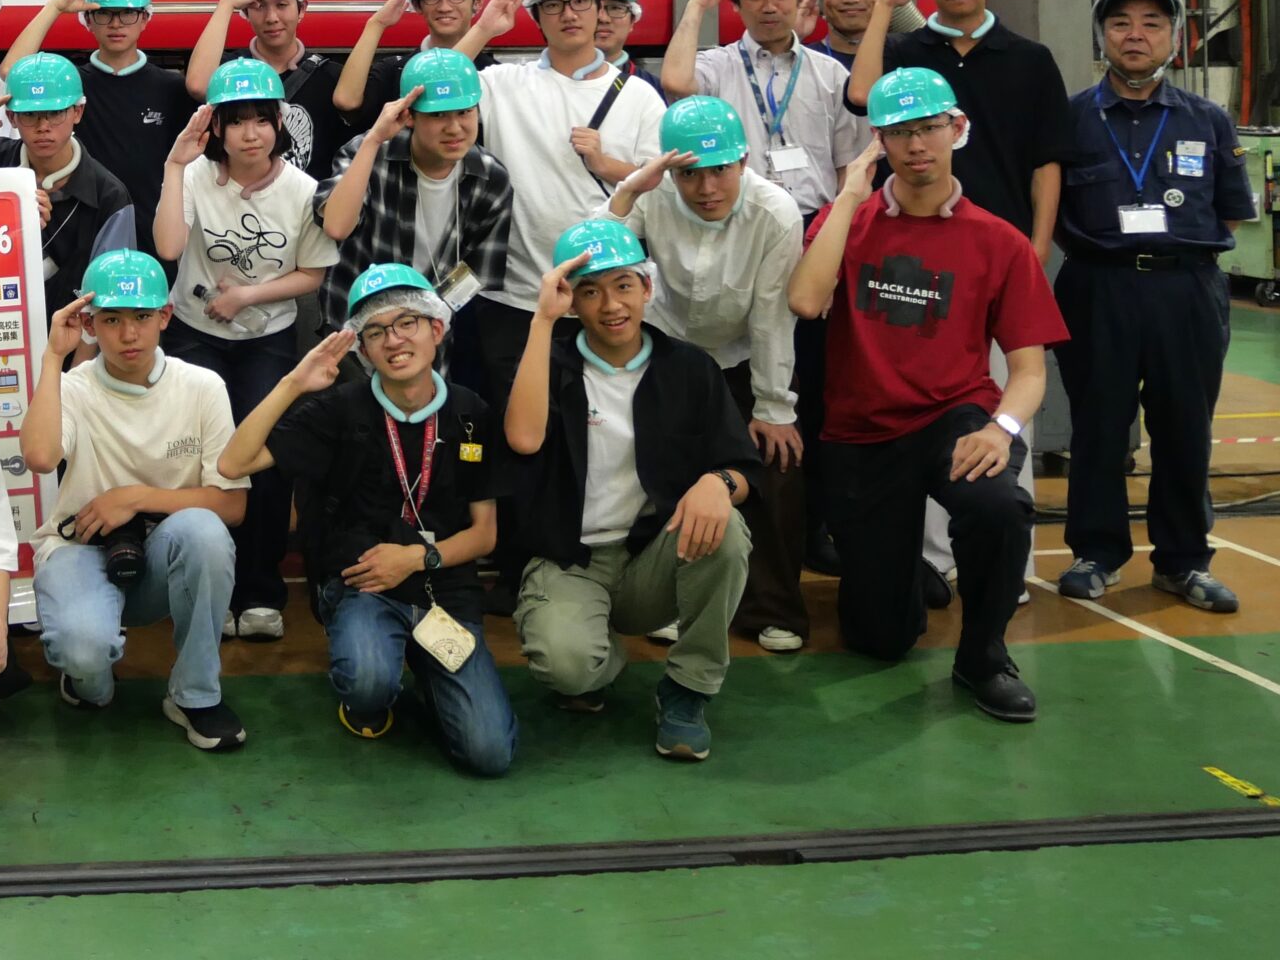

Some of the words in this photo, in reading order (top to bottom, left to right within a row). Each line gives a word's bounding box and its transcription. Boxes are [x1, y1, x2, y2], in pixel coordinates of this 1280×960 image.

[868, 280, 904, 294] BLACK
[906, 286, 942, 300] LABEL
[879, 292, 928, 306] CRESTBRIDGE
[166, 436, 201, 450] TOMMY
